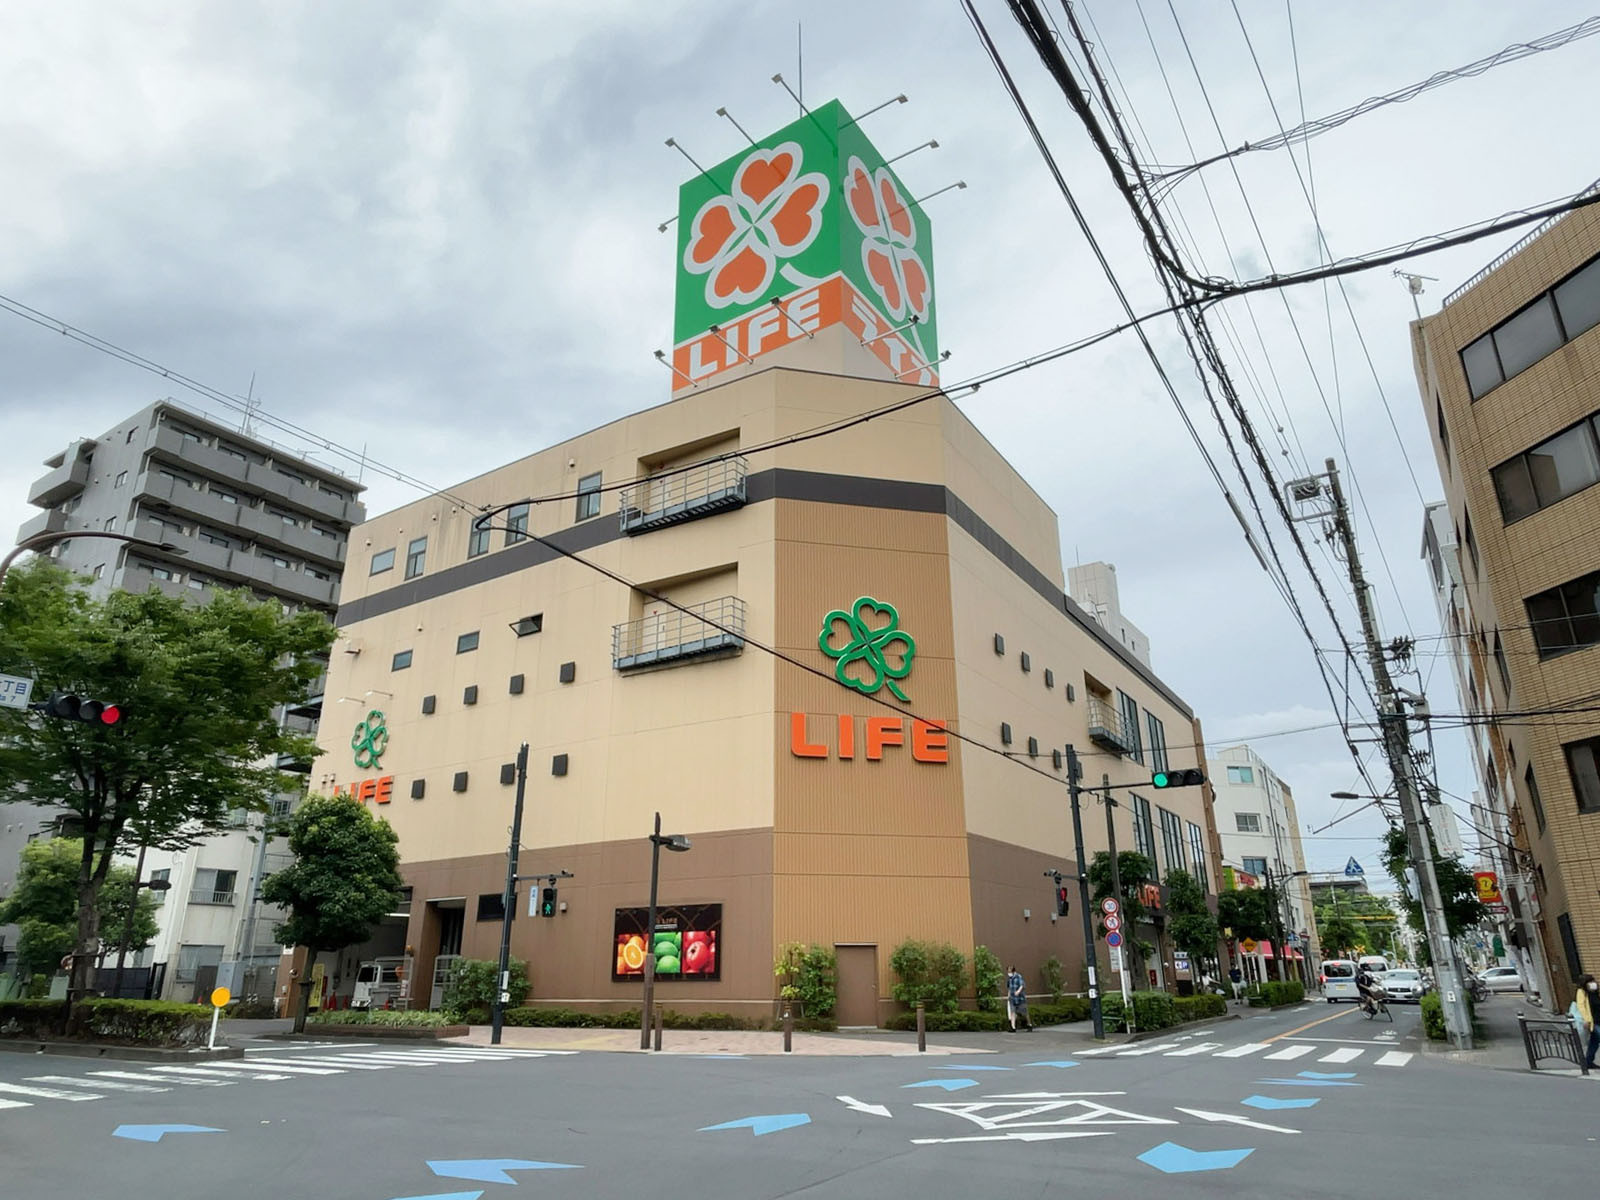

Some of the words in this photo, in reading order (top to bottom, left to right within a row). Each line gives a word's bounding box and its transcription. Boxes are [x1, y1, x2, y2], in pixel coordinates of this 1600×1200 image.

[689, 289, 820, 380] LIFE
[851, 295, 932, 386] ライフ
[790, 712, 948, 763] LIFE
